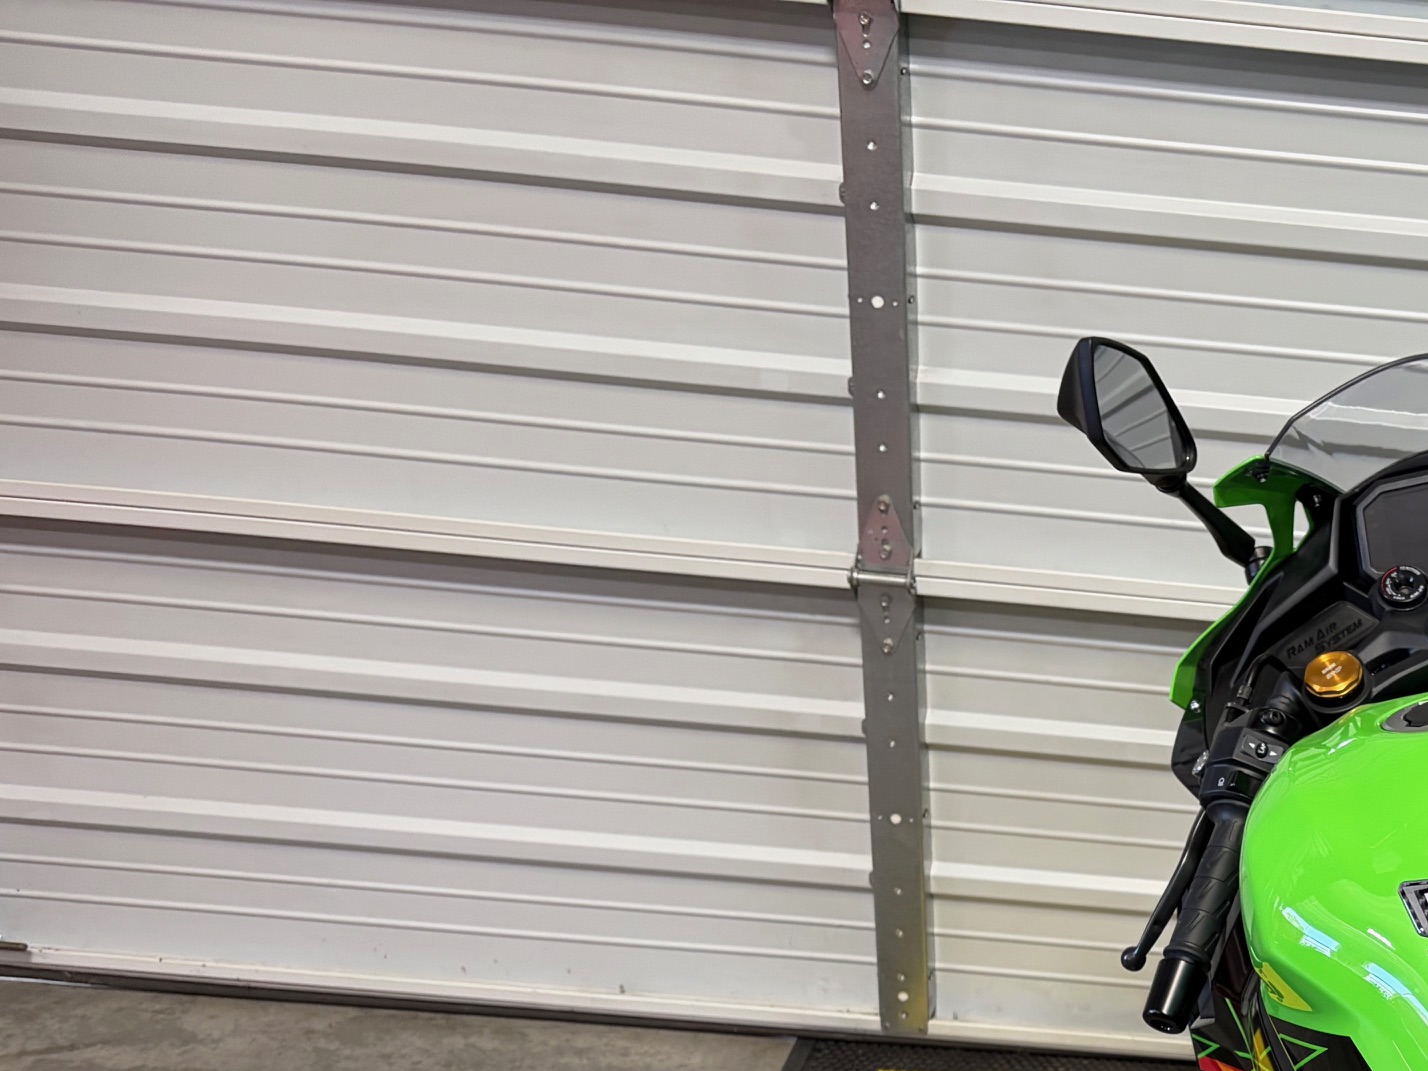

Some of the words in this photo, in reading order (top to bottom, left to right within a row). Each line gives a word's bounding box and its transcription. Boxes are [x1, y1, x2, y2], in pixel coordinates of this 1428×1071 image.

[1287, 636, 1314, 659] RAM
[1317, 622, 1337, 641] AIR
[1315, 619, 1362, 653] SYSTEM
